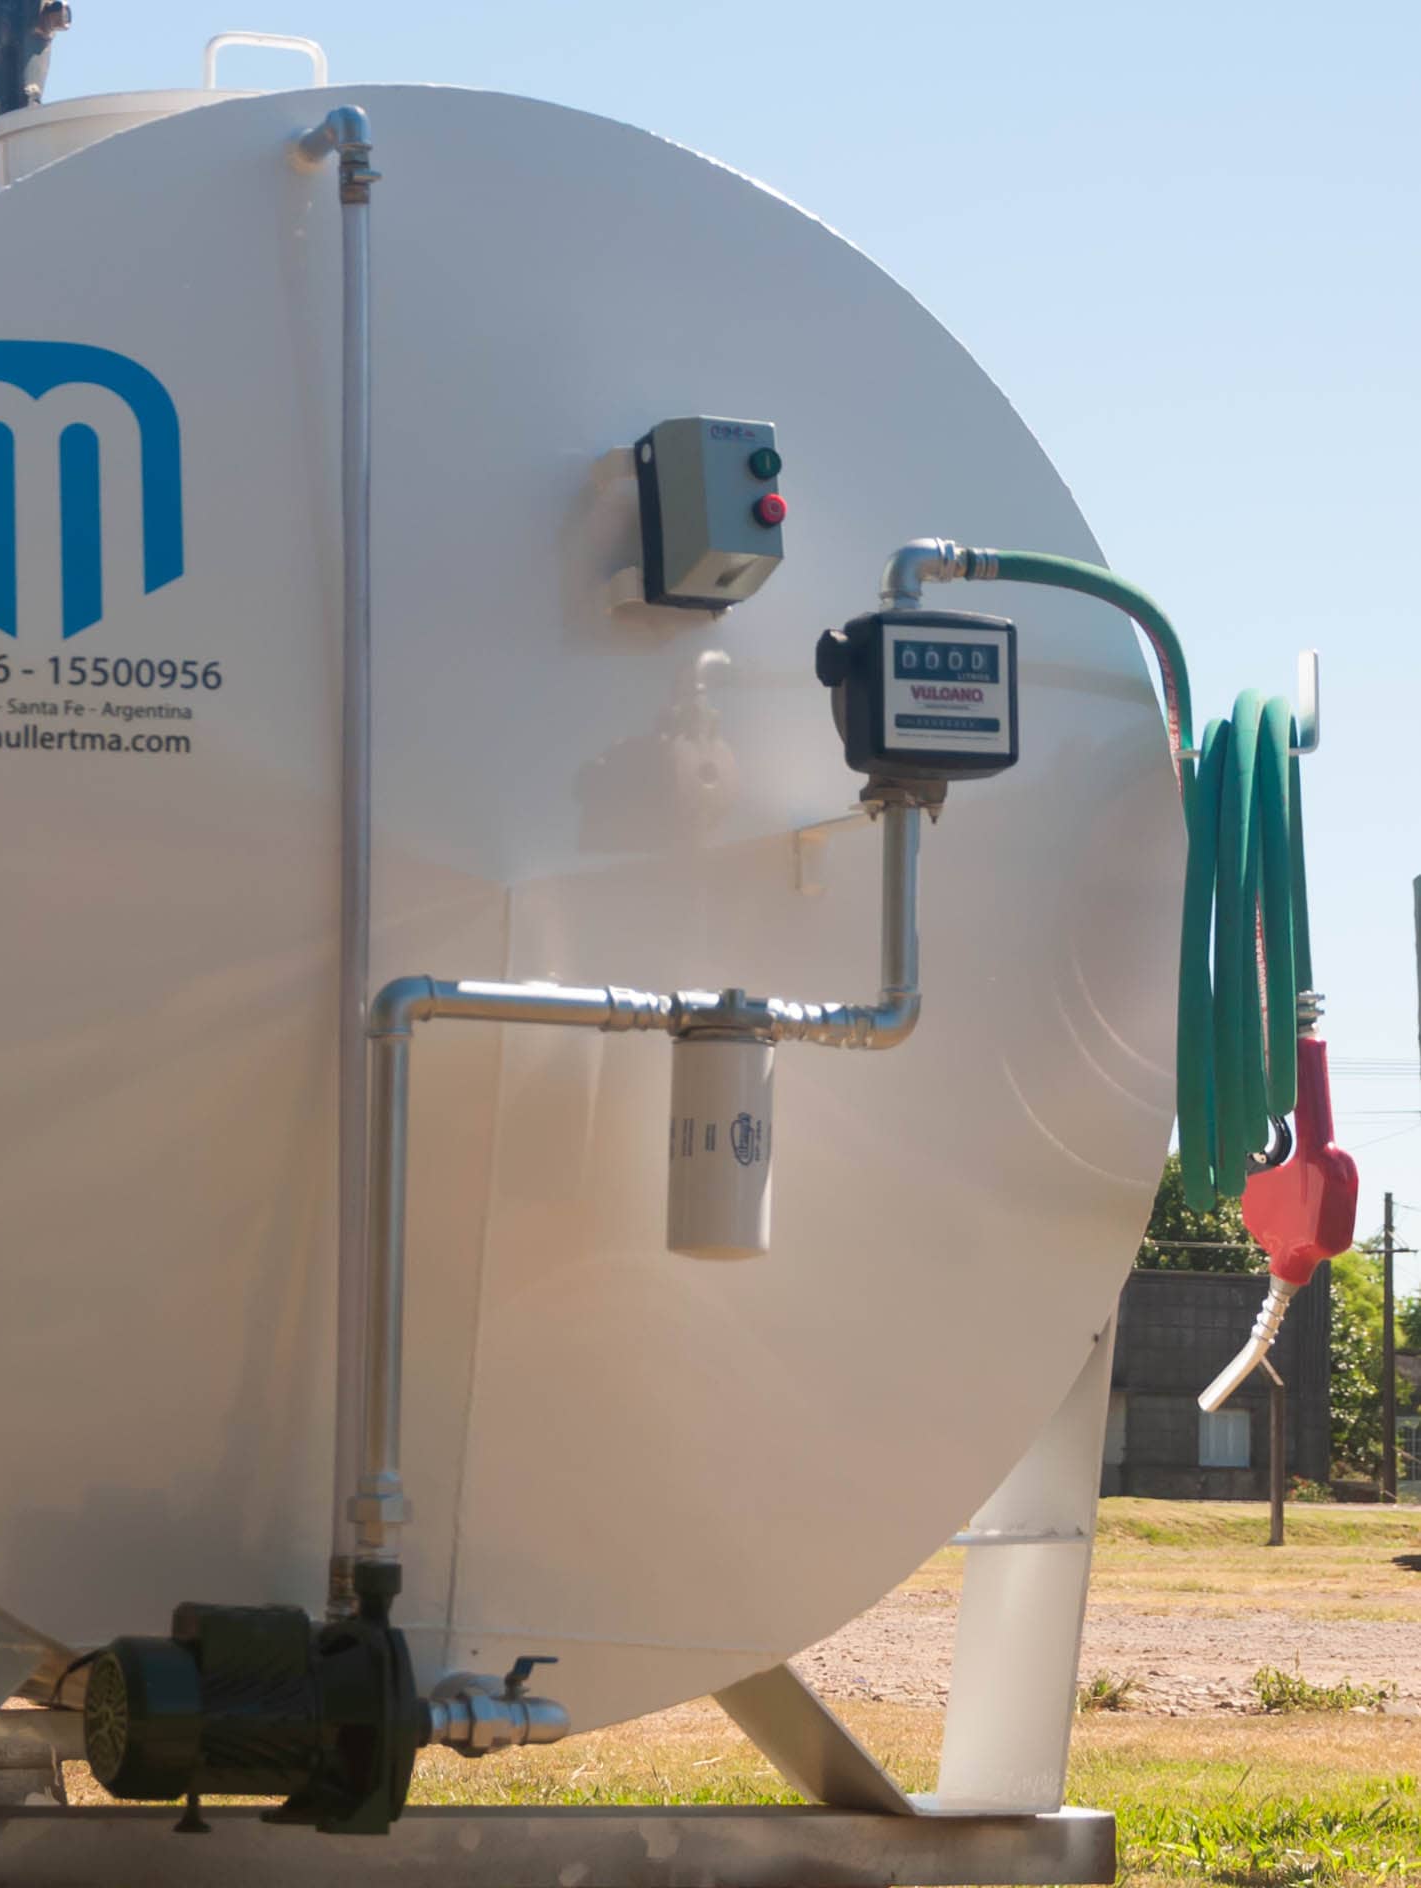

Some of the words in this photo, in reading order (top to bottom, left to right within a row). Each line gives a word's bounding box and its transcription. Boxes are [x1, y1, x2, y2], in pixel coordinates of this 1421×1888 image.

[48, 656, 222, 690] 15500956
[911, 686, 984, 702] VULCANO
[7, 699, 58, 716] Santa
[64, 700, 85, 716] Fe
[101, 702, 193, 722] Argentina
